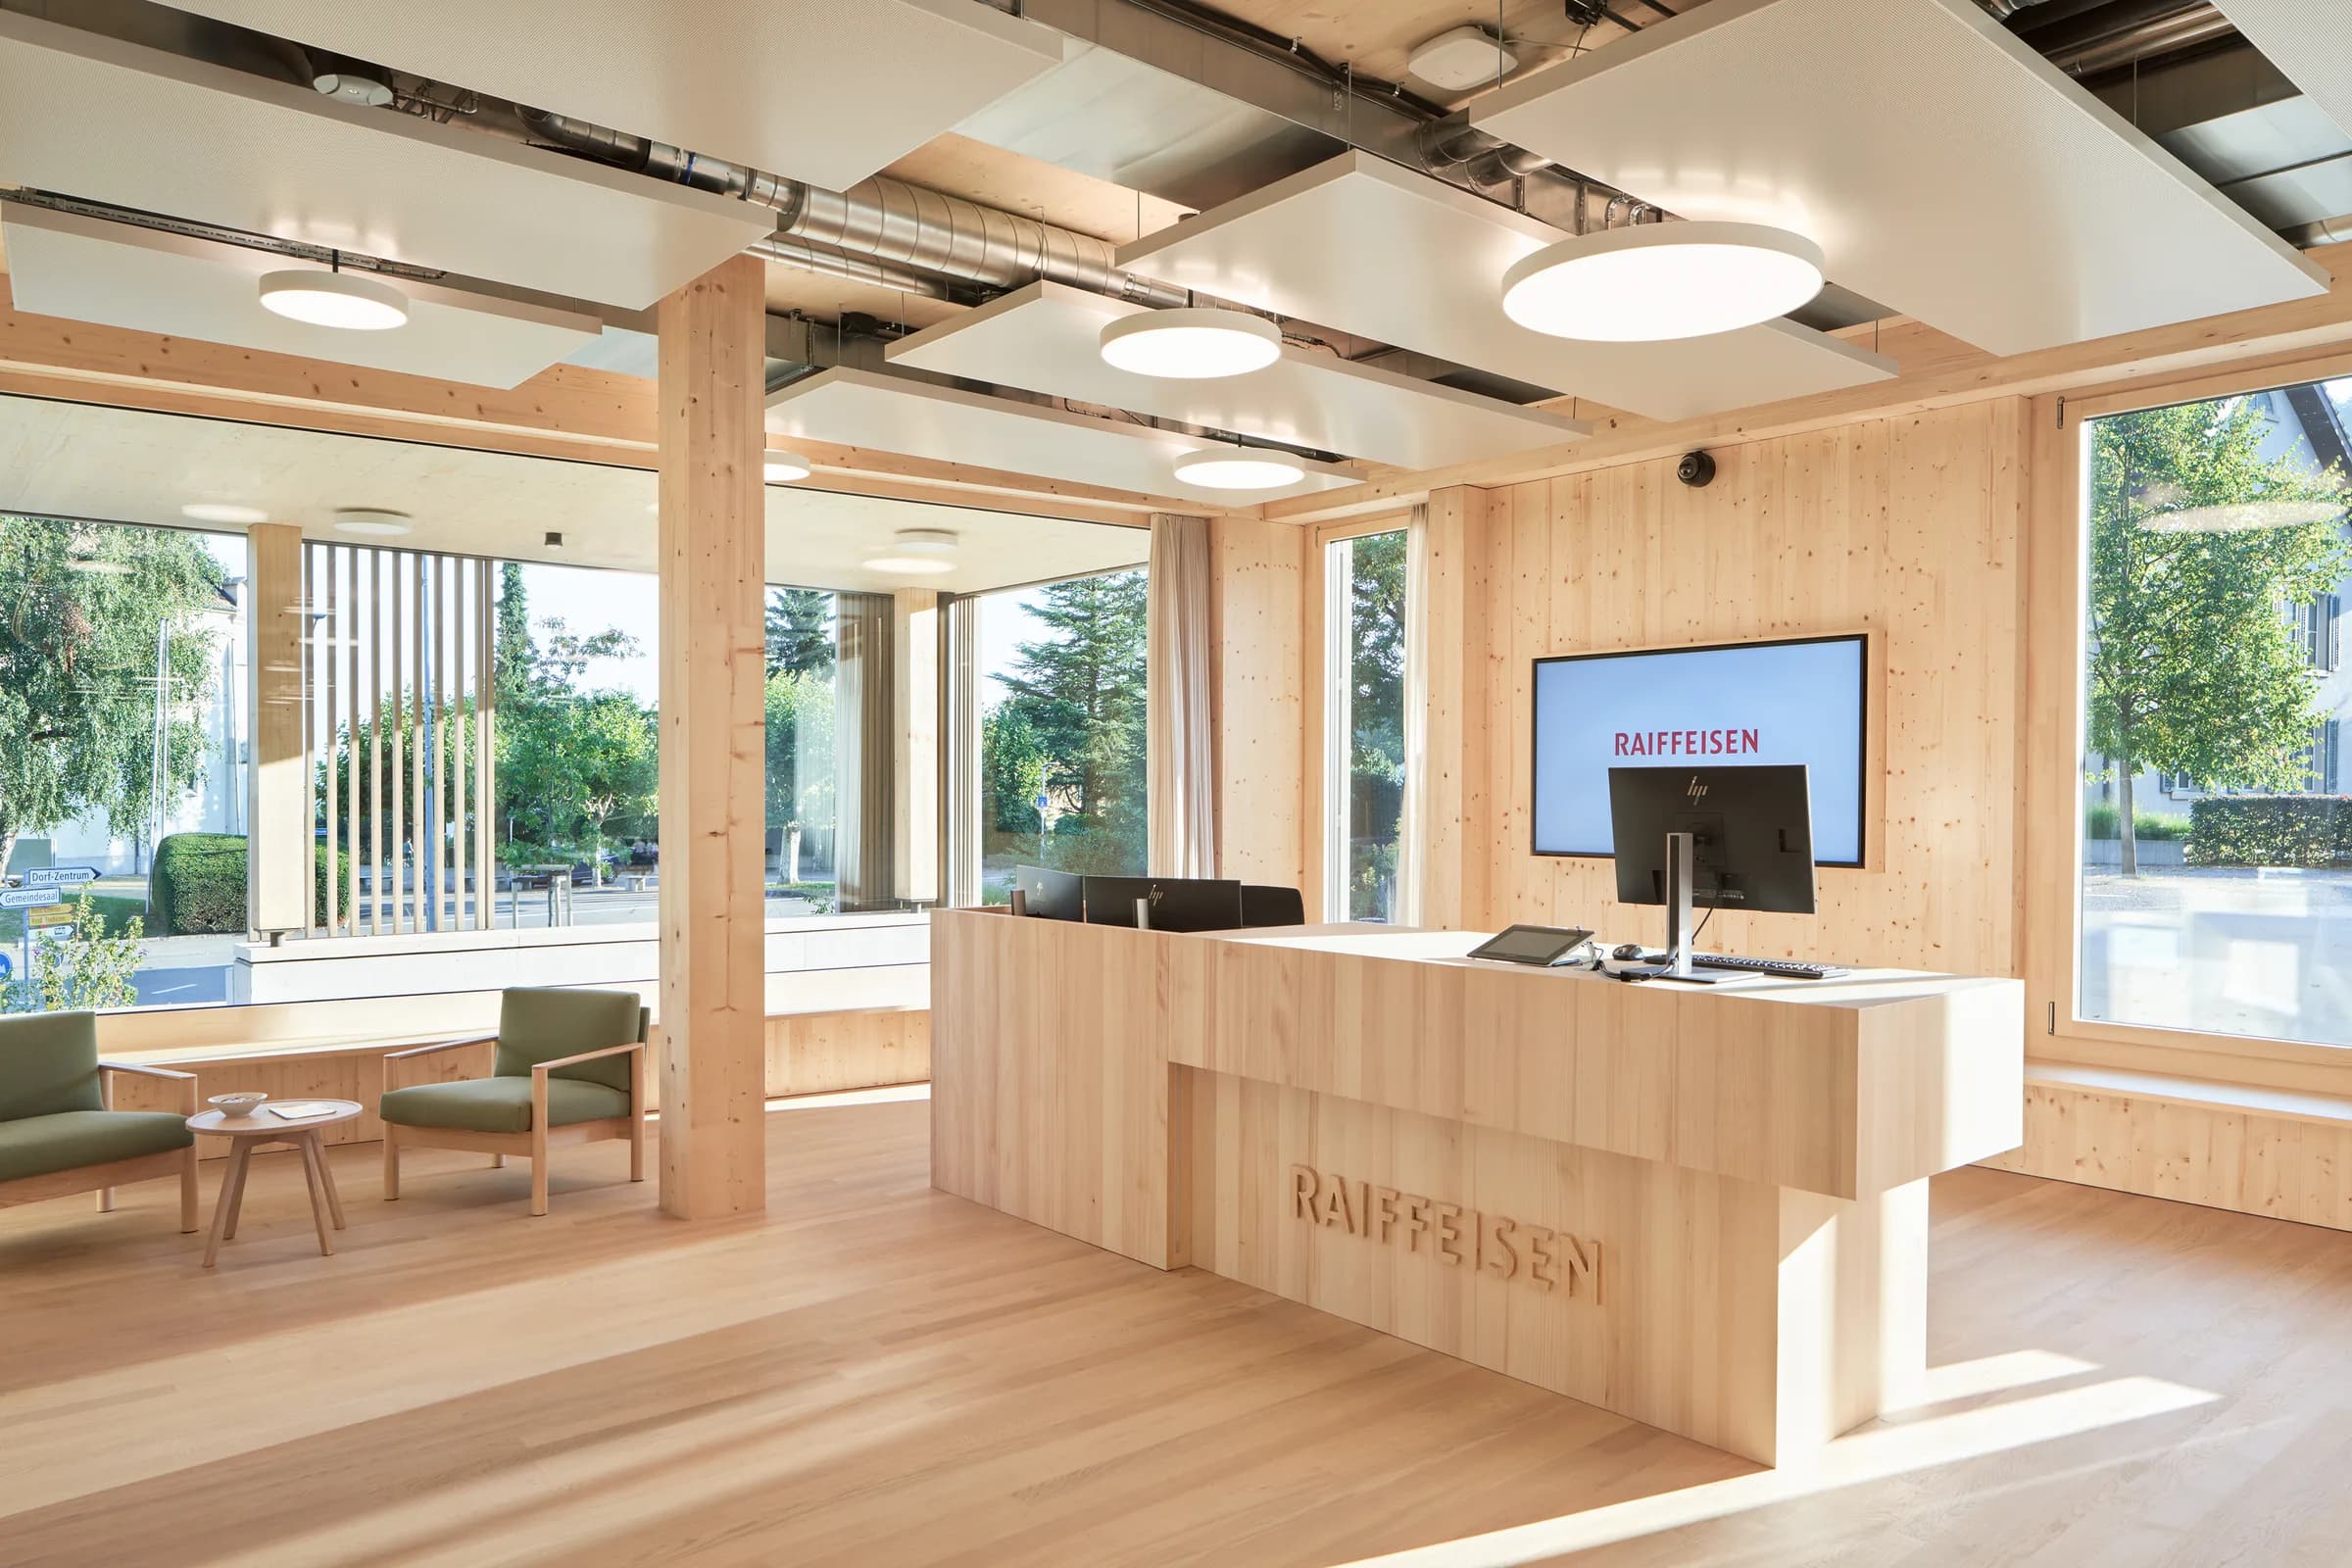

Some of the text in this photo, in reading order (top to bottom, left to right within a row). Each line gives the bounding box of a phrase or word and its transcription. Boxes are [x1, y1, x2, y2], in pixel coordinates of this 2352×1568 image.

[1614, 728, 1759, 757] RAIFFEISEN
[1687, 775, 1709, 807] hp
[31, 871, 90, 882] Dorf-Zentrum
[5, 892, 58, 904] Gemeindesaal
[1290, 1163, 1603, 1306] RAIFFEISEN
